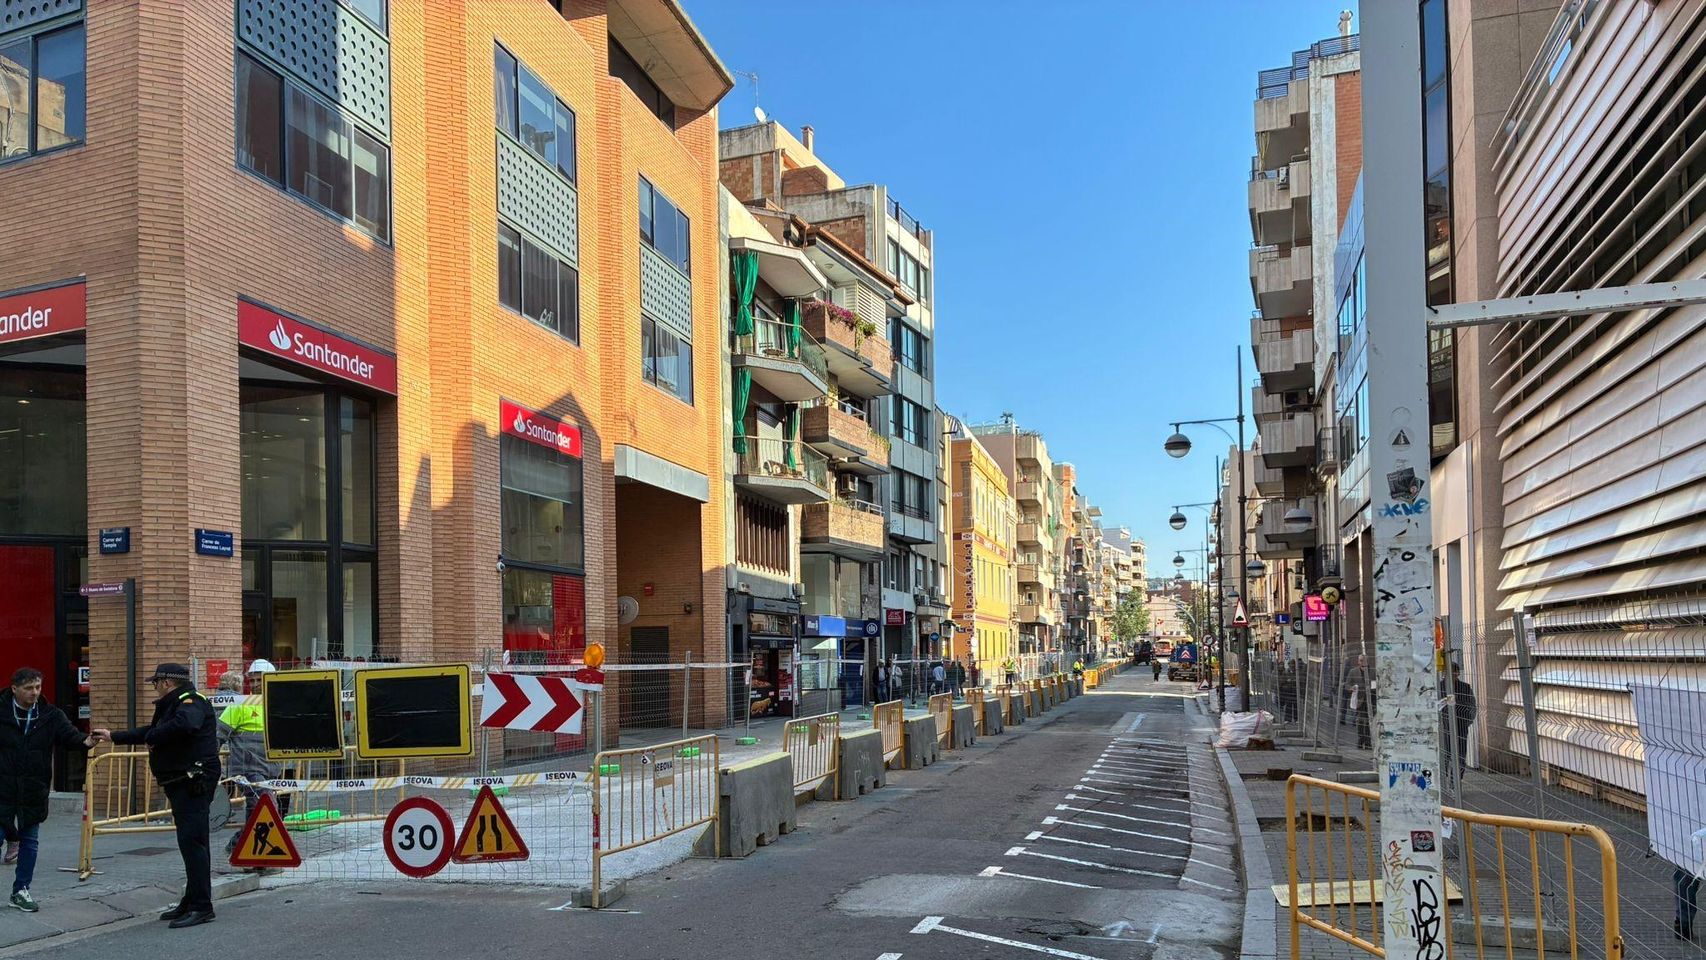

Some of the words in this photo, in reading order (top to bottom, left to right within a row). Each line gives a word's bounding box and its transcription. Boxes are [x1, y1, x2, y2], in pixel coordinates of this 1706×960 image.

[293, 332, 374, 379] Santander
[526, 419, 571, 449] Santander
[208, 696, 235, 704] SEOVA
[403, 776, 433, 785] ISEOVA
[546, 772, 577, 781] ISEOVA
[336, 780, 365, 788] ISEOVA
[473, 777, 504, 786] ISEOVA
[398, 824, 438, 851] 30
